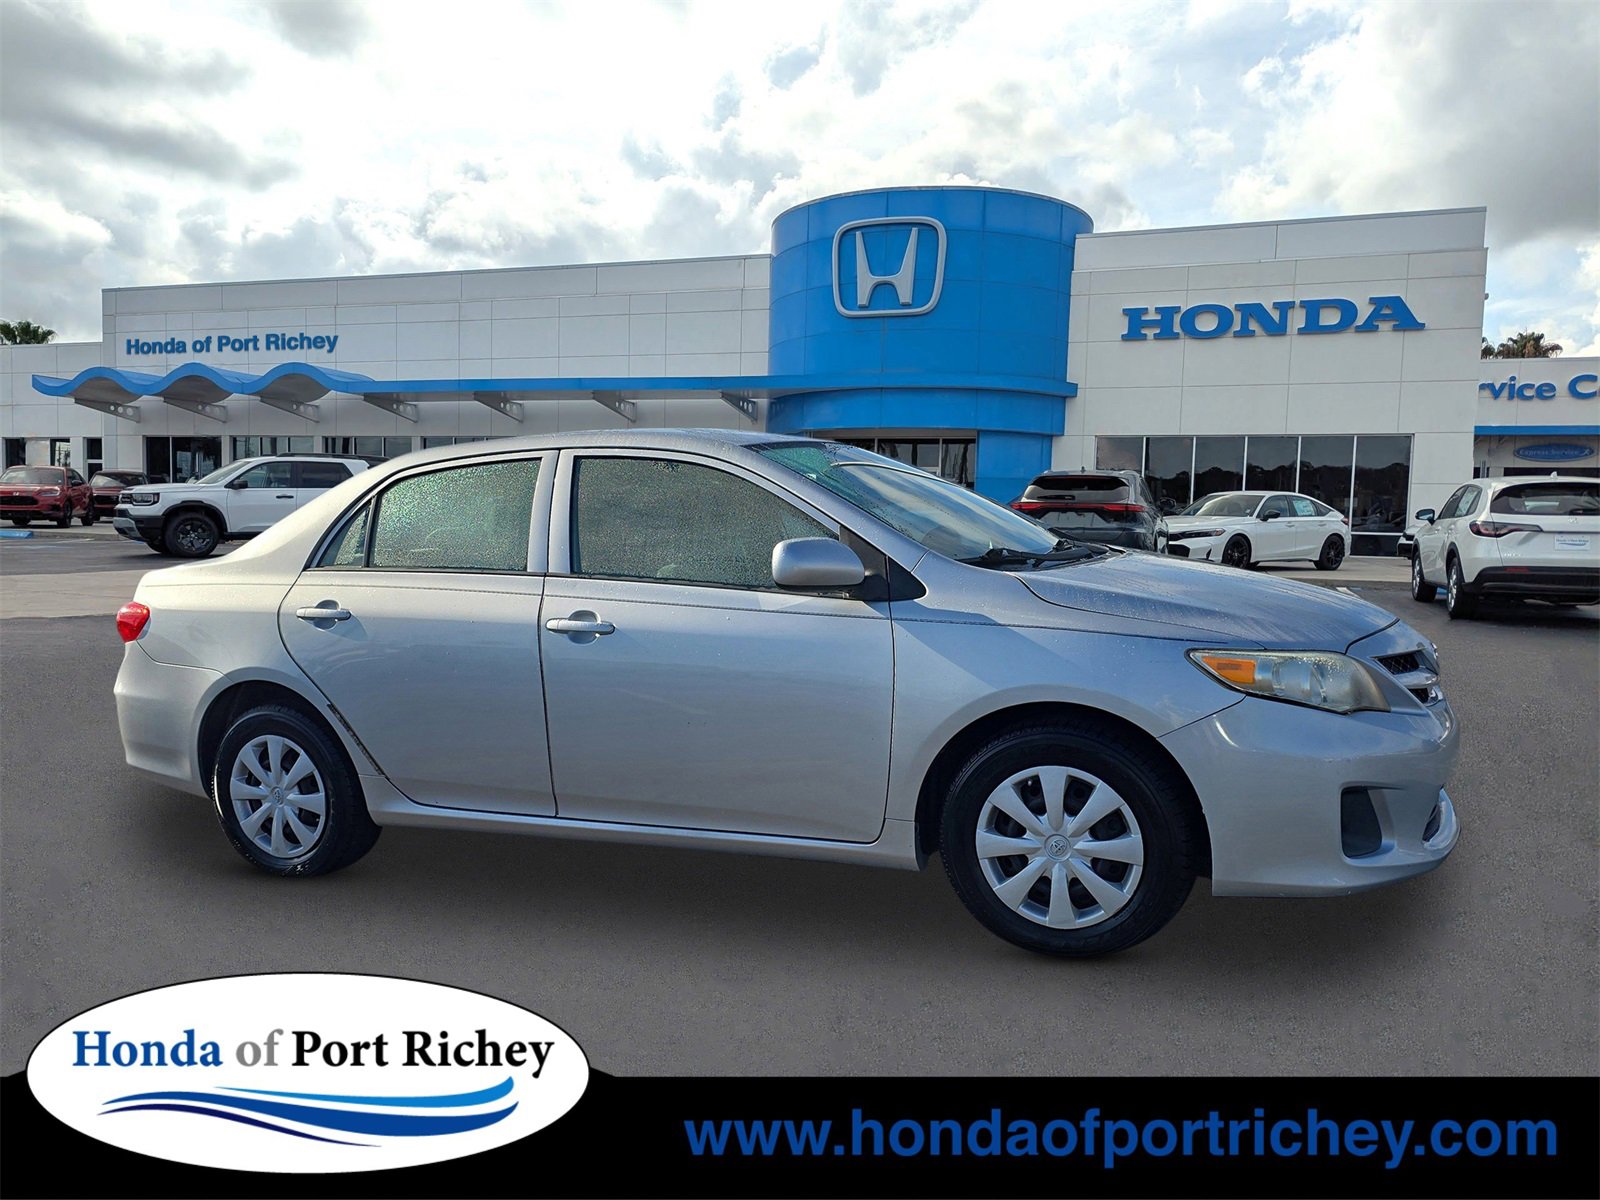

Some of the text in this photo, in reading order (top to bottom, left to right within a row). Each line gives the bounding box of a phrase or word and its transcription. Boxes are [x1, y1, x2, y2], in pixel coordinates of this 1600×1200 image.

[1120, 295, 1425, 341] HONDA
[125, 331, 340, 355] Honda of Port Richey
[1567, 373, 1600, 400] C
